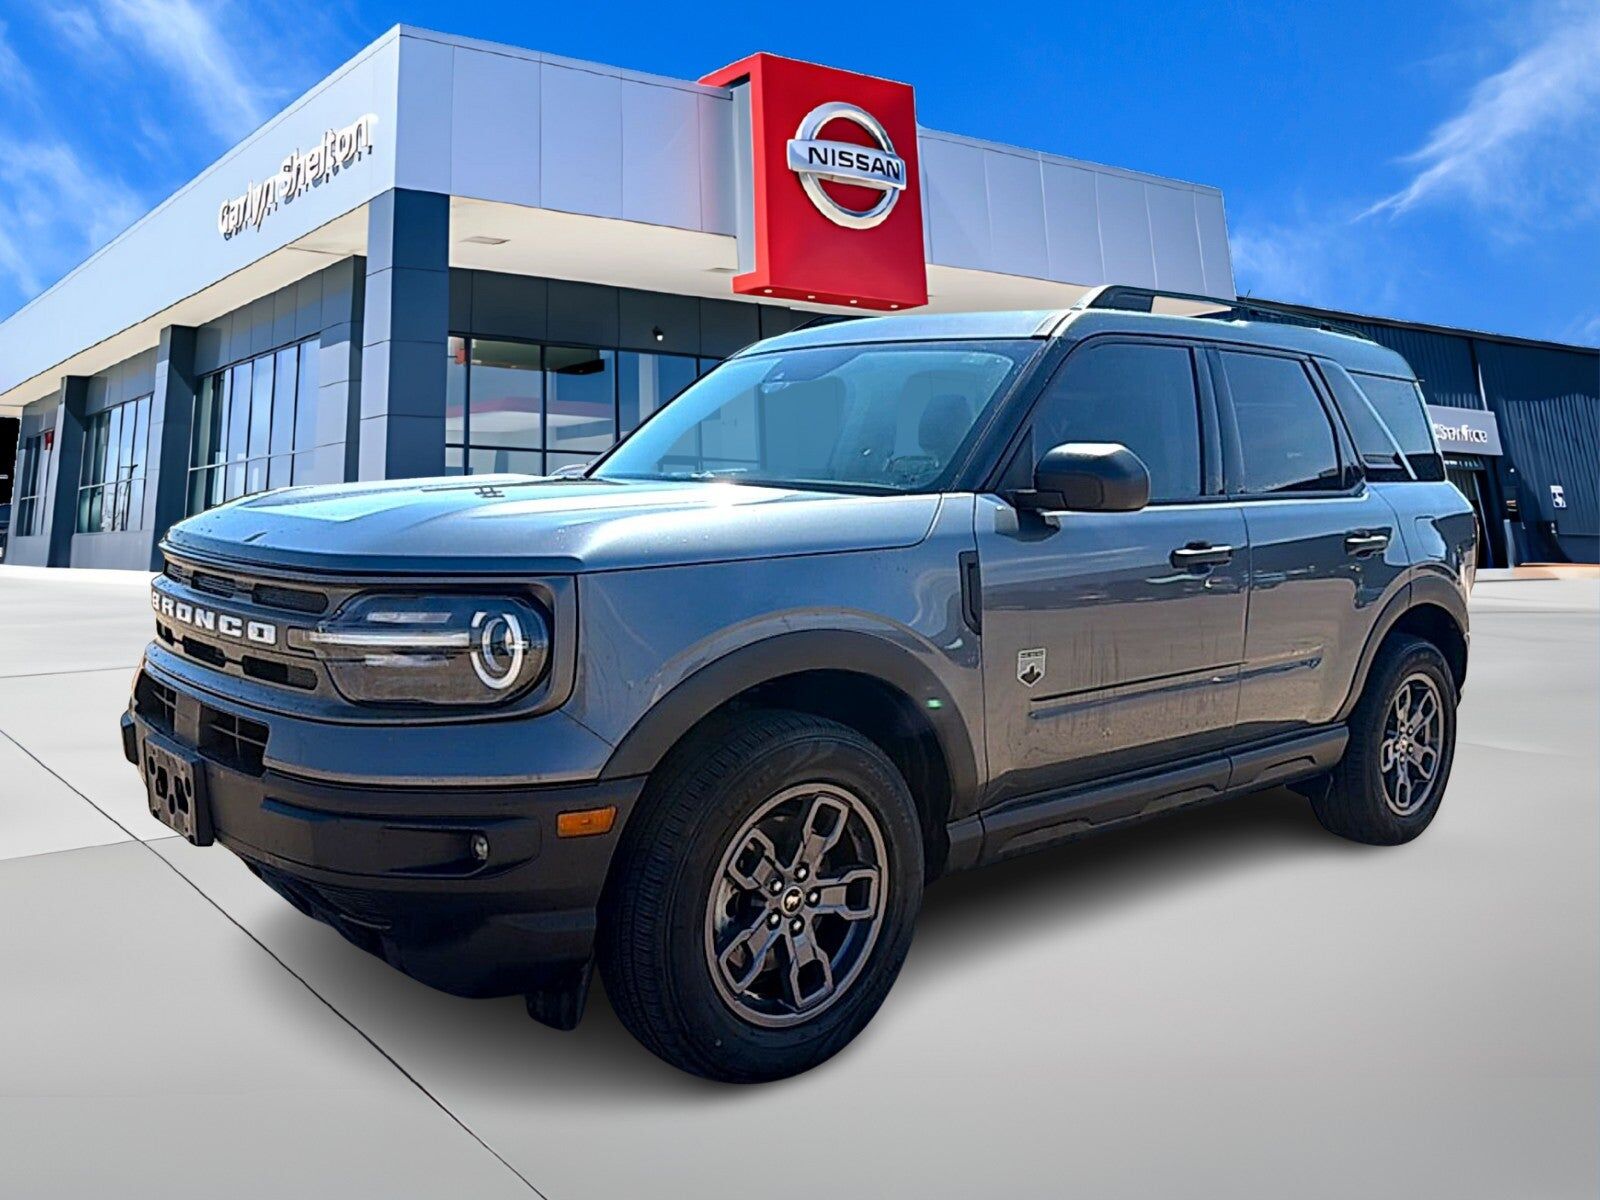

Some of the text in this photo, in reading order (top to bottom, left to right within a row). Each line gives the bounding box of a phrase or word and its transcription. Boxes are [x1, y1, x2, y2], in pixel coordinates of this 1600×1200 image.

[278, 114, 374, 203] Shelton
[808, 147, 900, 180] NISSAN
[152, 591, 276, 645] BRONCO
